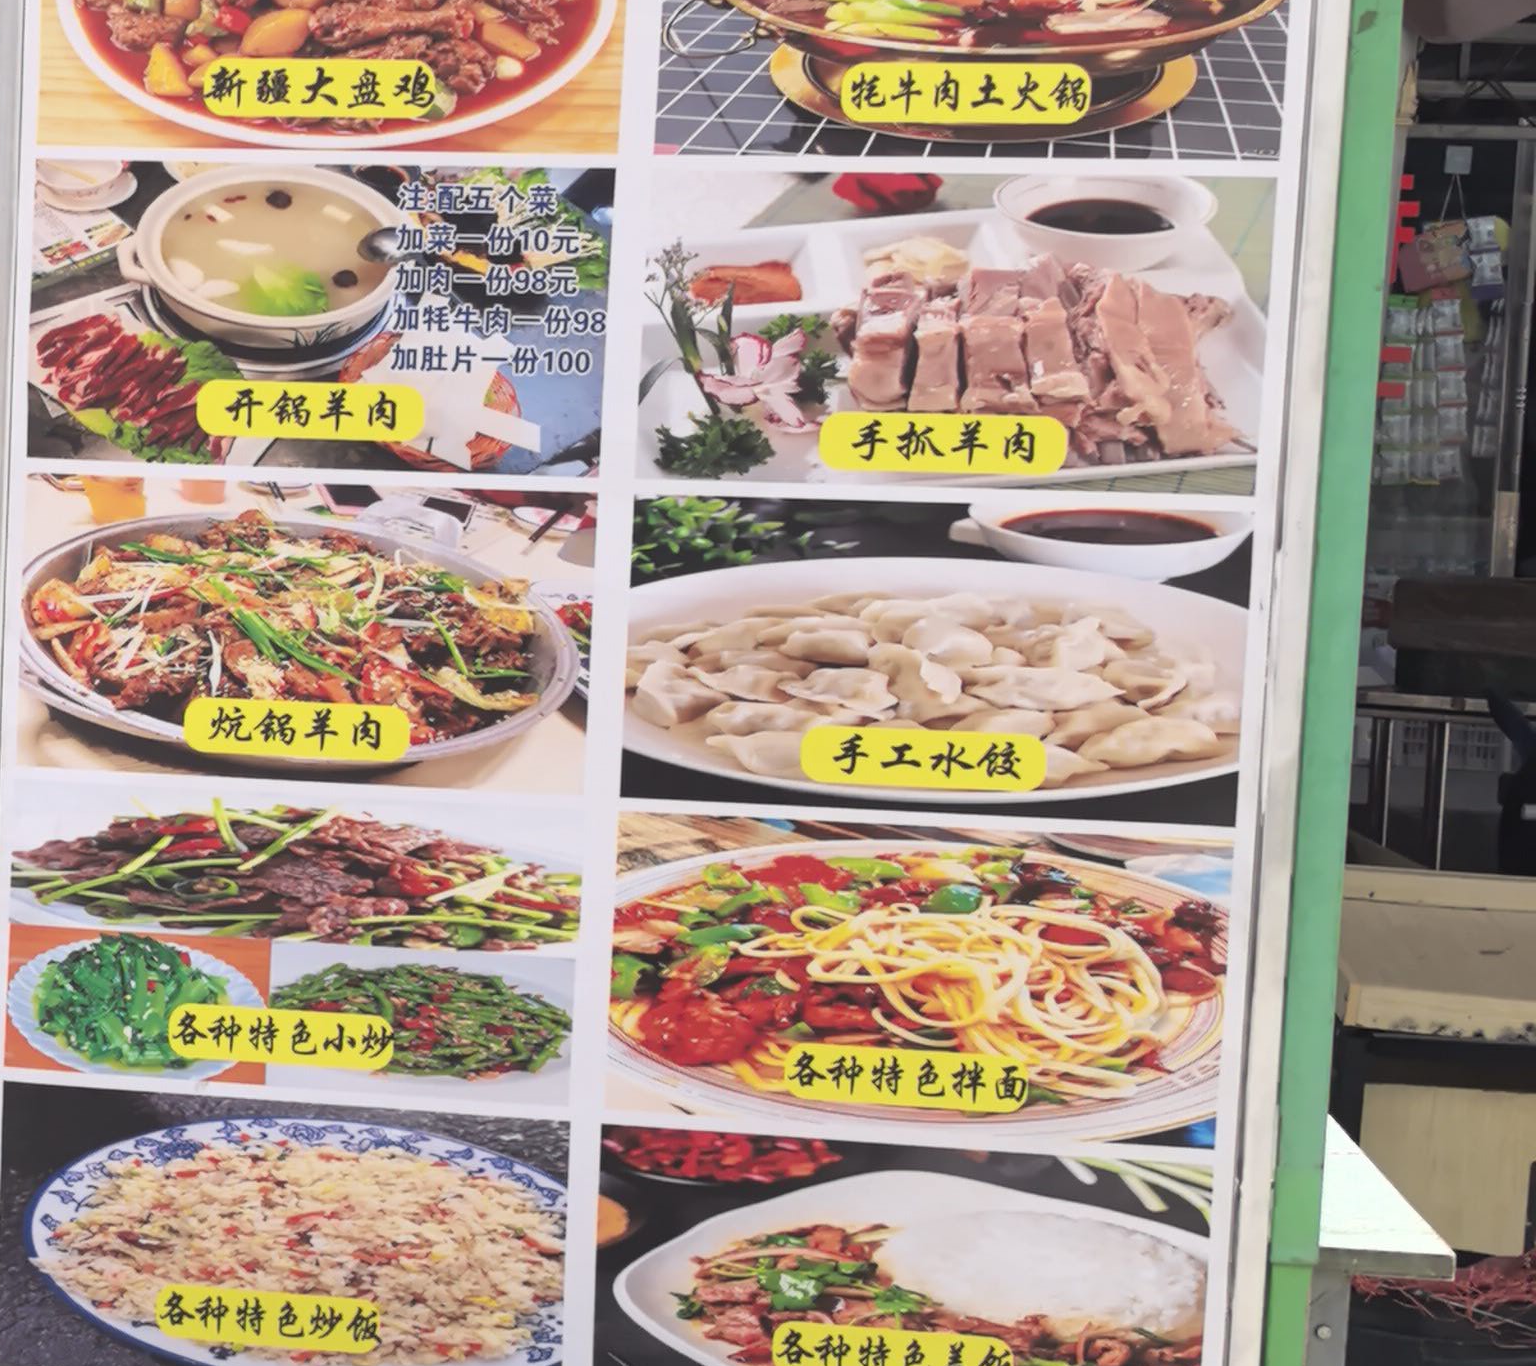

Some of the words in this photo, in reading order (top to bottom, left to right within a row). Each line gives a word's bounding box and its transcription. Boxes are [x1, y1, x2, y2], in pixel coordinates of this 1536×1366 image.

[207, 65, 435, 110] 新疆大盘鸡
[851, 69, 1089, 115] 牦牛肉土火锅
[396, 225, 580, 255] 加菜一份10元
[394, 264, 578, 295] 加肉一份98元
[393, 304, 607, 334] 加牦牛肉一份98
[390, 344, 591, 374] 加肚片一份100
[225, 388, 397, 431] 开锅羊肉
[852, 420, 1036, 464] 手抓羊肉
[208, 707, 382, 751] 炕锅羊肉
[833, 733, 1022, 780] 手工水饺
[172, 1010, 395, 1058] 各种特色小炒
[788, 1049, 1028, 1107] 各种特色拌面
[160, 1290, 381, 1344] 各种特色炒饭
